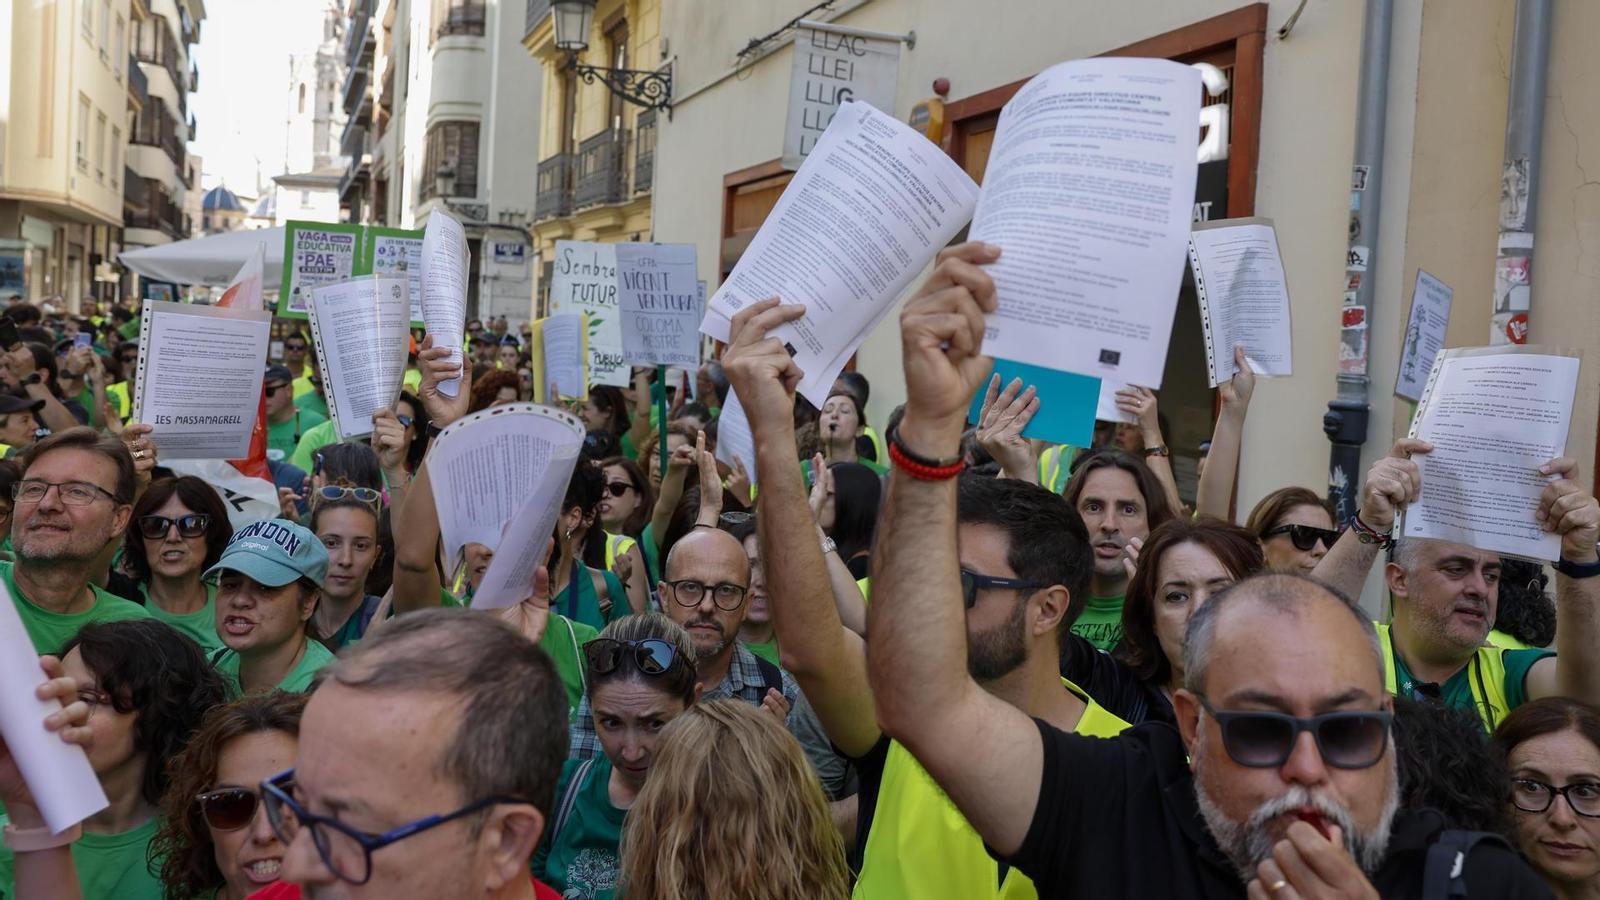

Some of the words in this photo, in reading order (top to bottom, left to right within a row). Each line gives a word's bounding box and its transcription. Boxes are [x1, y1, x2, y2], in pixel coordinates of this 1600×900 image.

[811, 29, 866, 56] LLAC
[808, 53, 854, 82] LLEI
[805, 80, 854, 106] LLIG
[298, 231, 328, 242] VAGA
[298, 240, 352, 253] EDUCATIVA
[624, 268, 671, 291] VICENT
[571, 283, 618, 306] FUTUR
[638, 294, 696, 311] VENTURA
[635, 316, 684, 334] COLOMA
[642, 334, 681, 349] MESTRE
[154, 415, 172, 425] IES
[174, 415, 242, 425] MASSAMAGRELL
[227, 520, 302, 557] LONDON
[241, 541, 270, 551] Original
